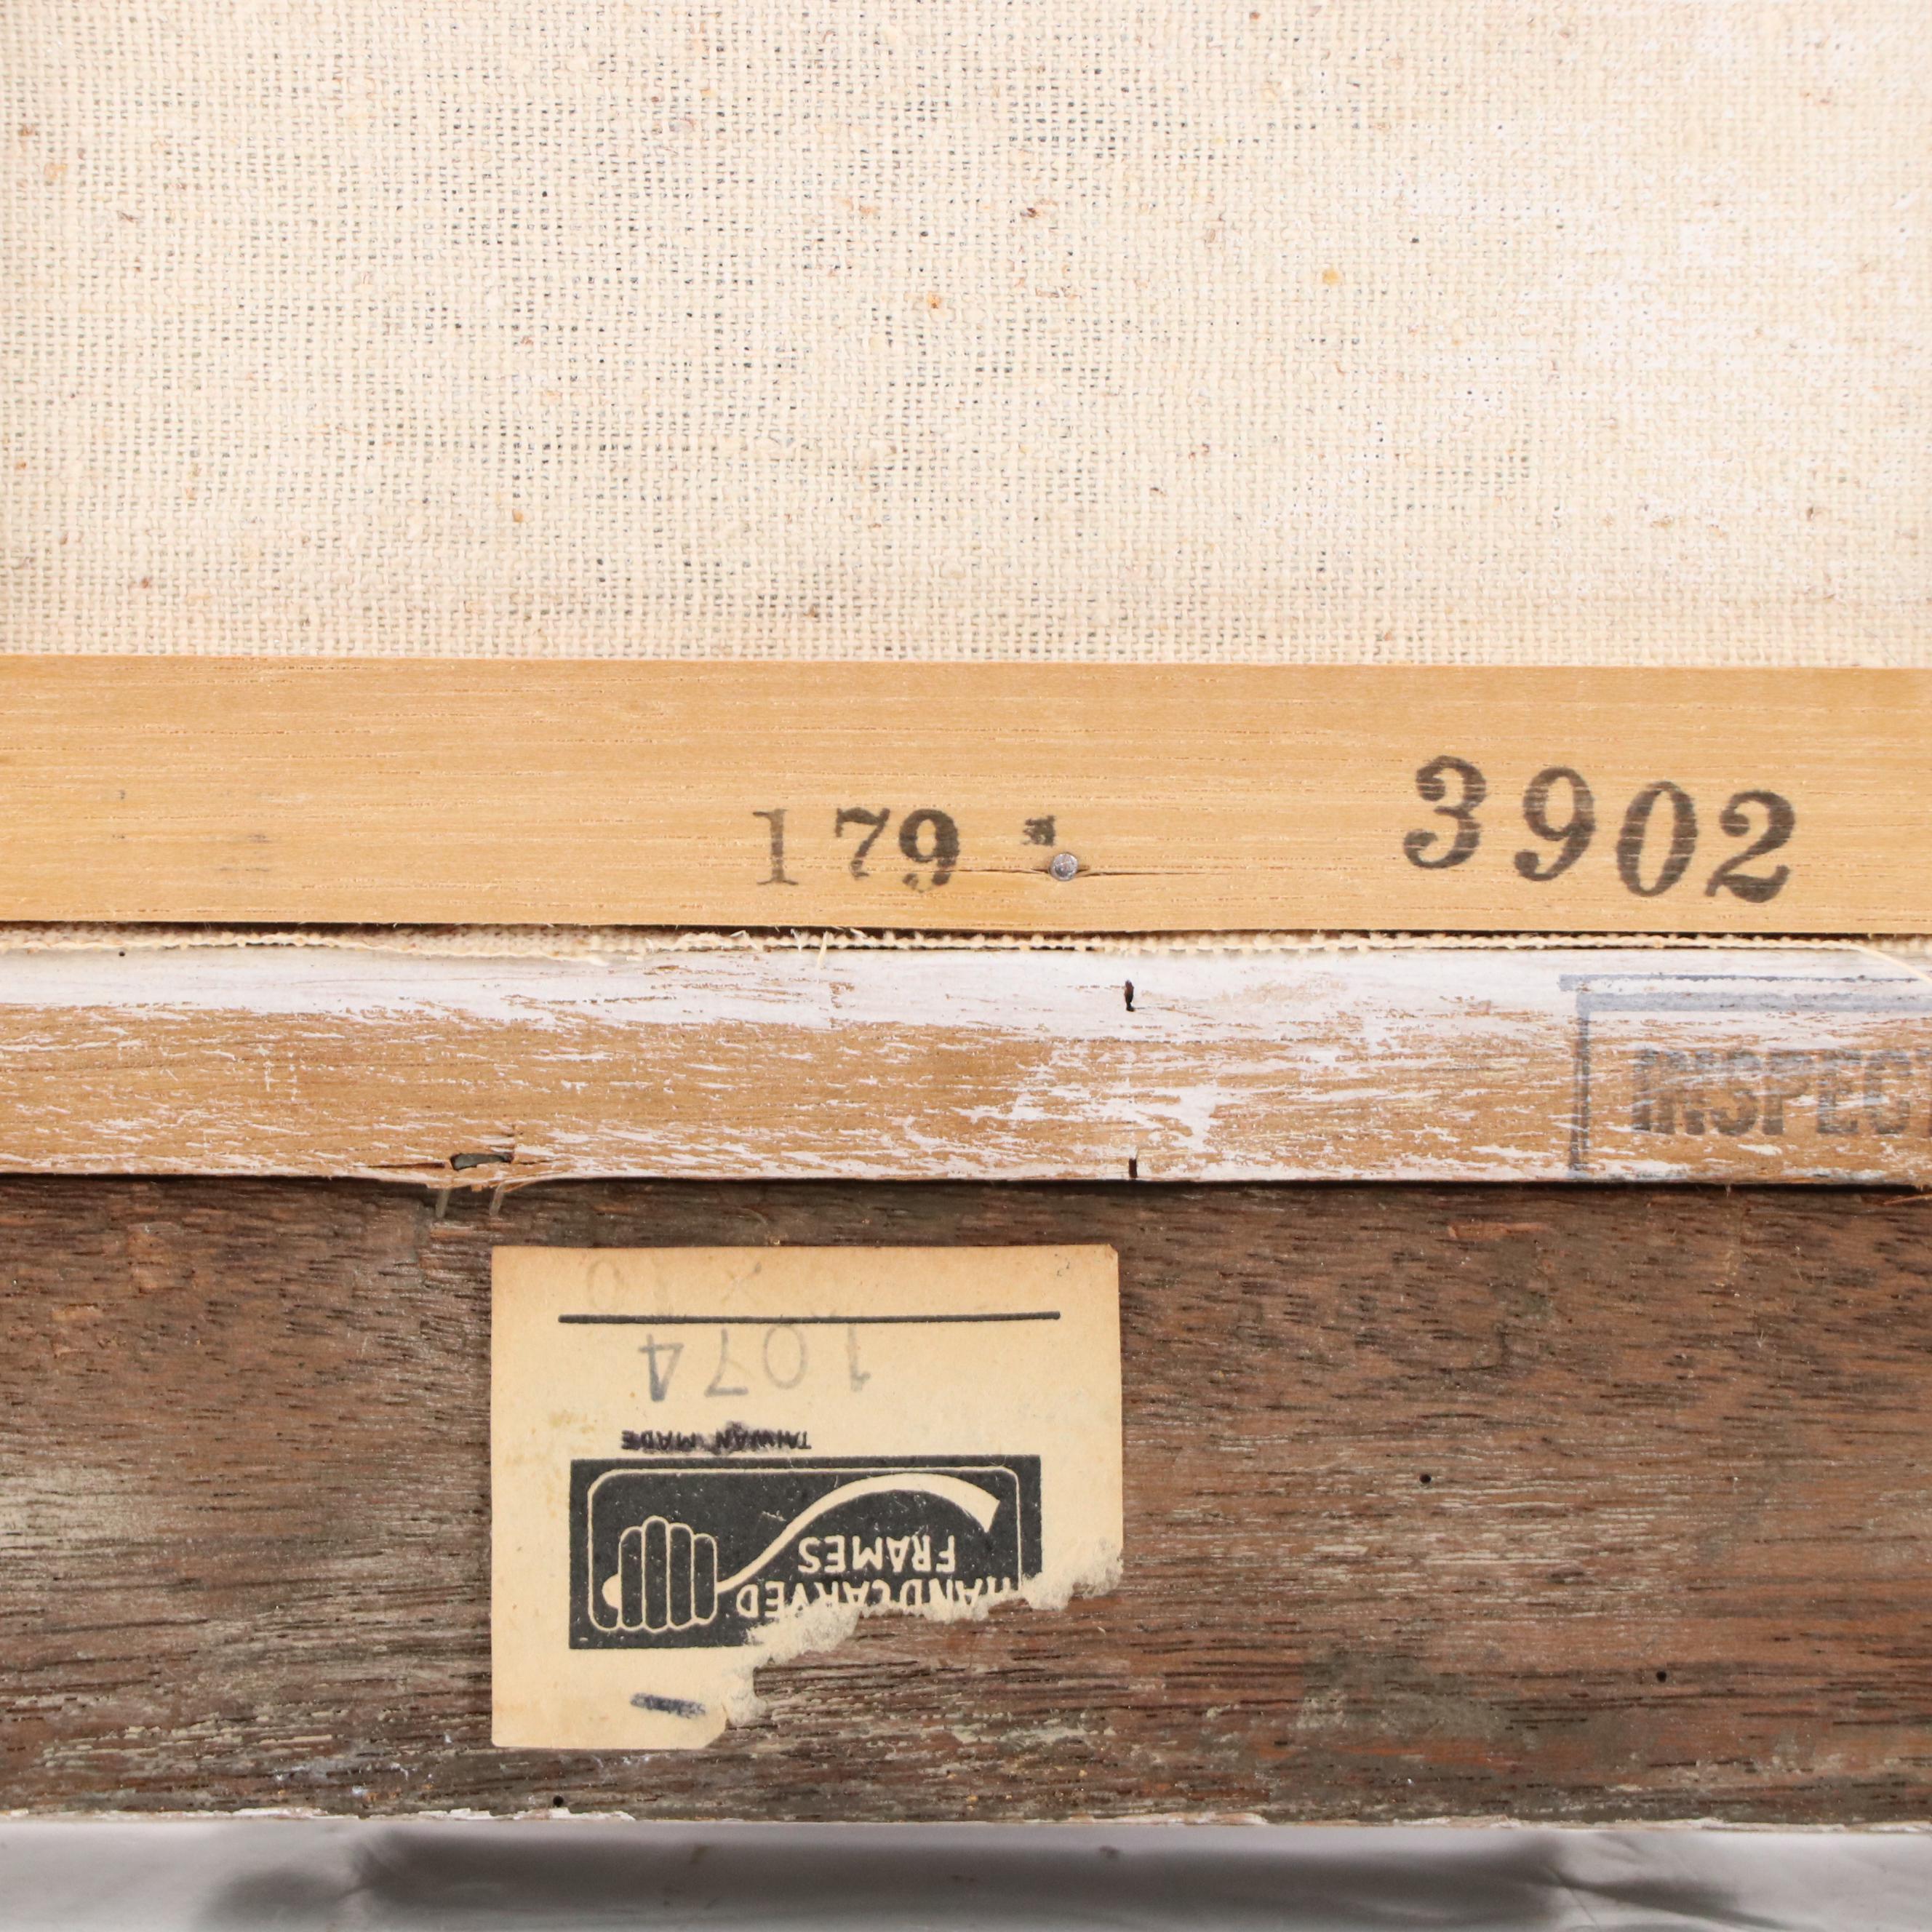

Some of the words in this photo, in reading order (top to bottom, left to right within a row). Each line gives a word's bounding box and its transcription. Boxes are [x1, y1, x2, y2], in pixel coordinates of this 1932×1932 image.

[752, 806, 961, 893] 179
[1402, 754, 1796, 903] 3902
[638, 1324, 871, 1402] 1074
[620, 1429, 697, 1450] MADE
[797, 1535, 956, 1573] FRAMES
